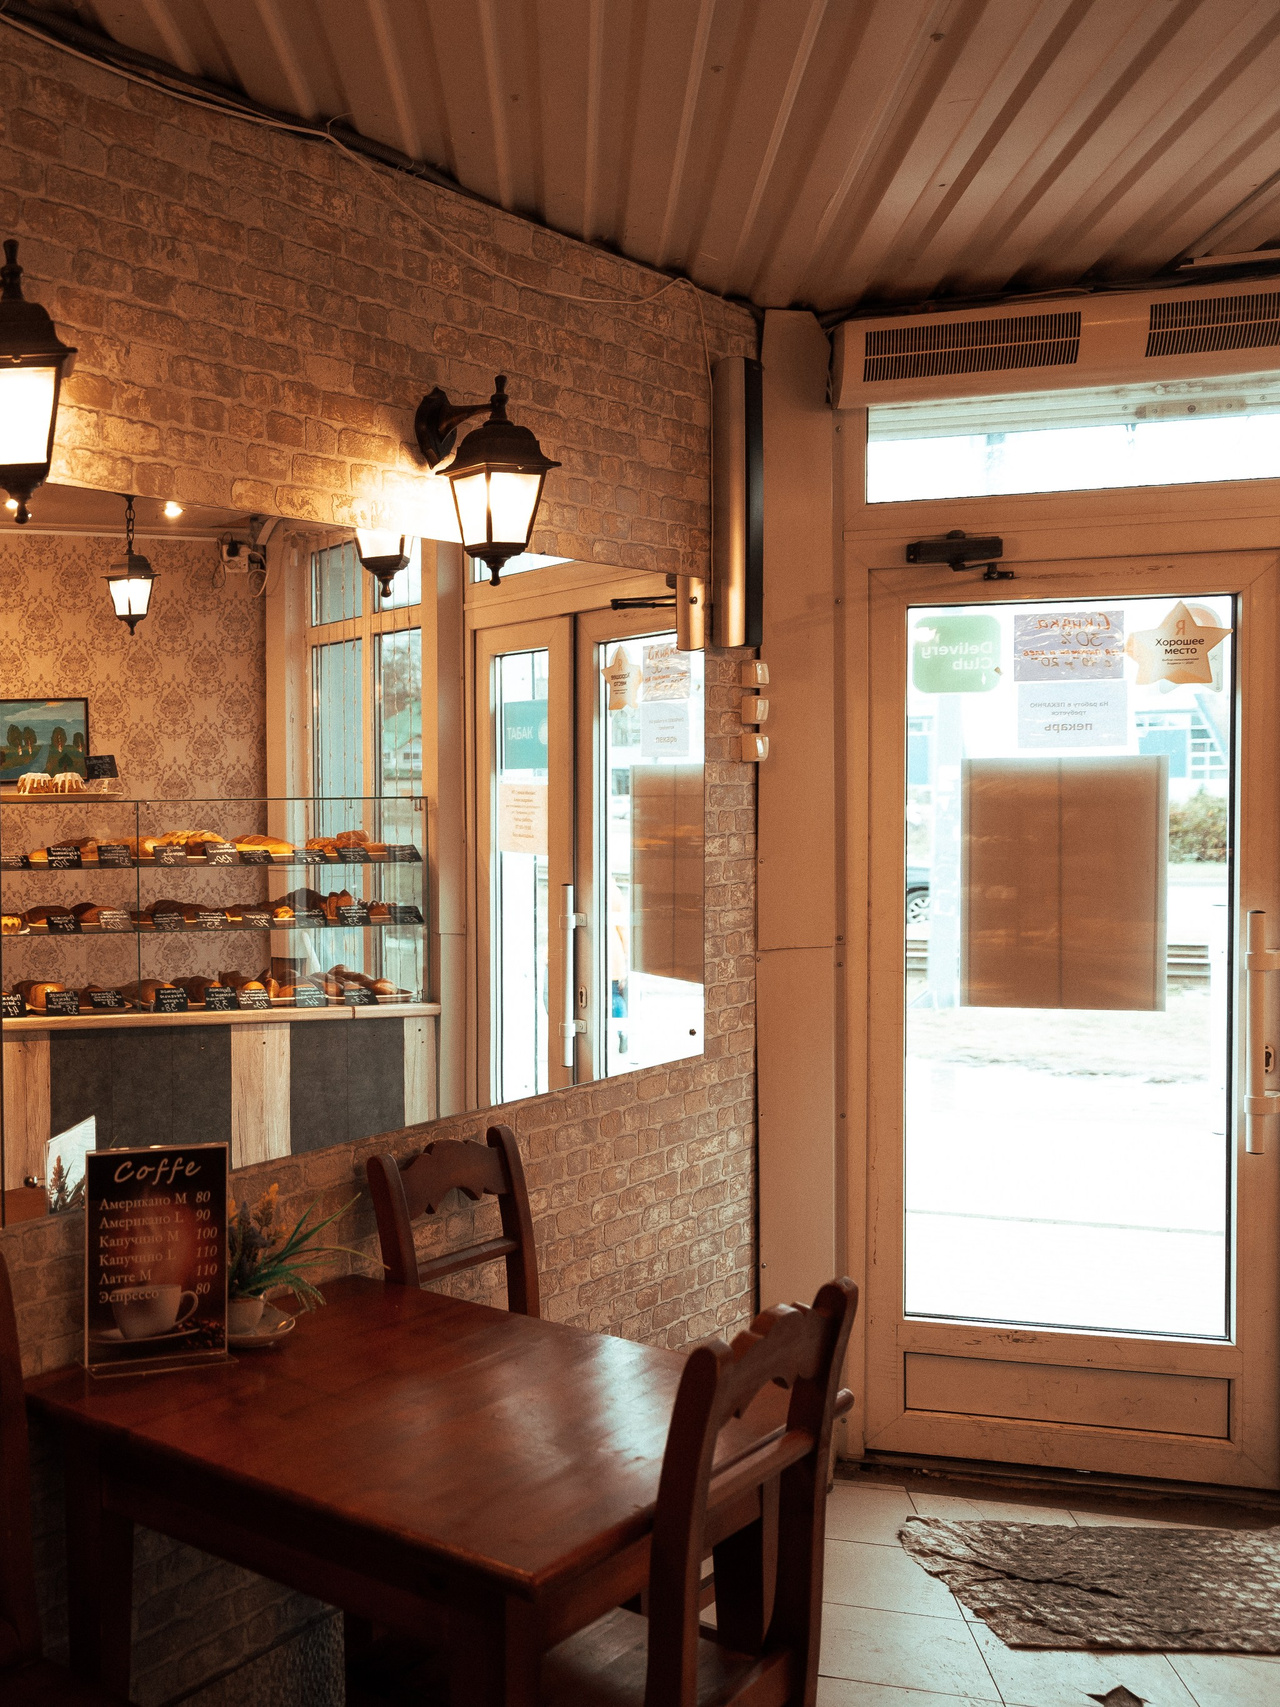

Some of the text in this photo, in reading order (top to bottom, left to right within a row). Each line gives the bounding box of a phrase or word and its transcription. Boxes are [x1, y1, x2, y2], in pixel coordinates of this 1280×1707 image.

[1155, 638, 1204, 647] Хорошее
[507, 726, 533, 740] ТАБАК
[113, 1157, 201, 1185] Coffe
[99, 1197, 171, 1212] Американо
[195, 1191, 211, 1203] 80
[99, 1215, 170, 1230] Американо
[196, 1209, 211, 1221] 90
[99, 1233, 163, 1249] Капучино
[196, 1227, 218, 1239] 100
[99, 1251, 163, 1268] Капучино
[196, 1246, 218, 1257] 110
[99, 1272, 136, 1286] Латте
[196, 1264, 218, 1276] 110
[99, 1283, 211, 1306] Эспрессо 80
